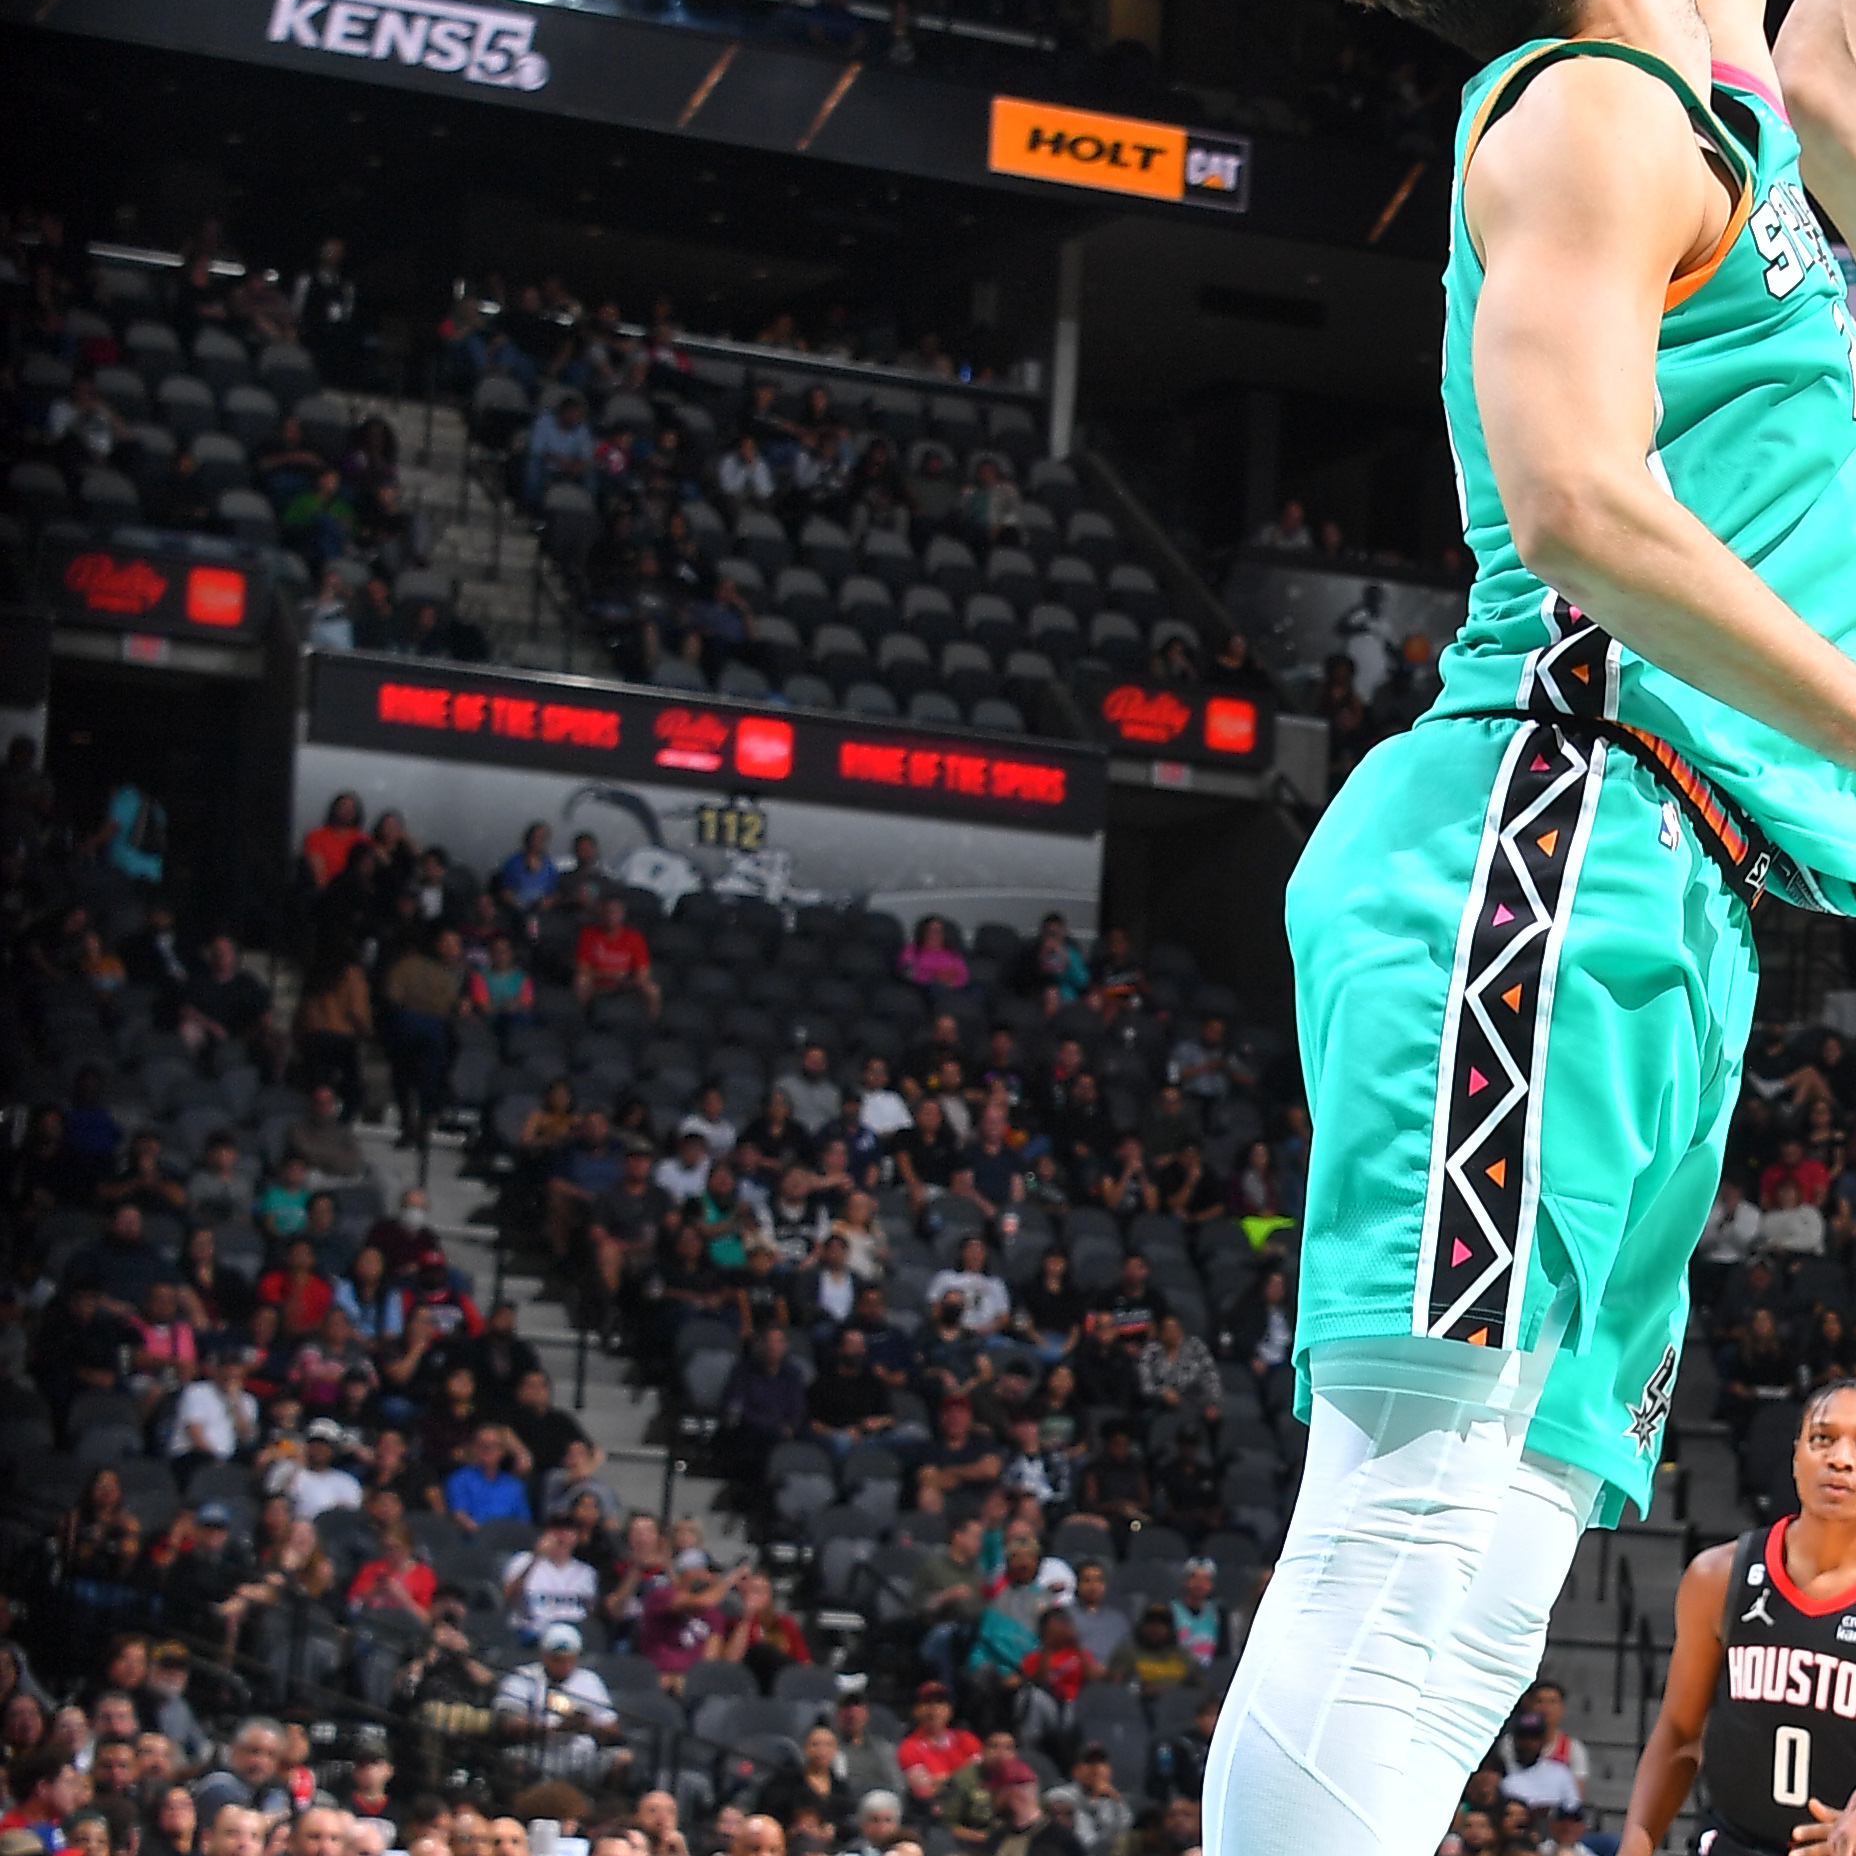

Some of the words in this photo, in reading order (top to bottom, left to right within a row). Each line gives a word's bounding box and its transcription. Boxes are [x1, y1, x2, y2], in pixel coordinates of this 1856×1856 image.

[1026, 126, 1168, 172] HOLT
[702, 808, 765, 848] 112
[1746, 1562, 1766, 1587] 6
[1773, 1725, 1811, 1807] 0
